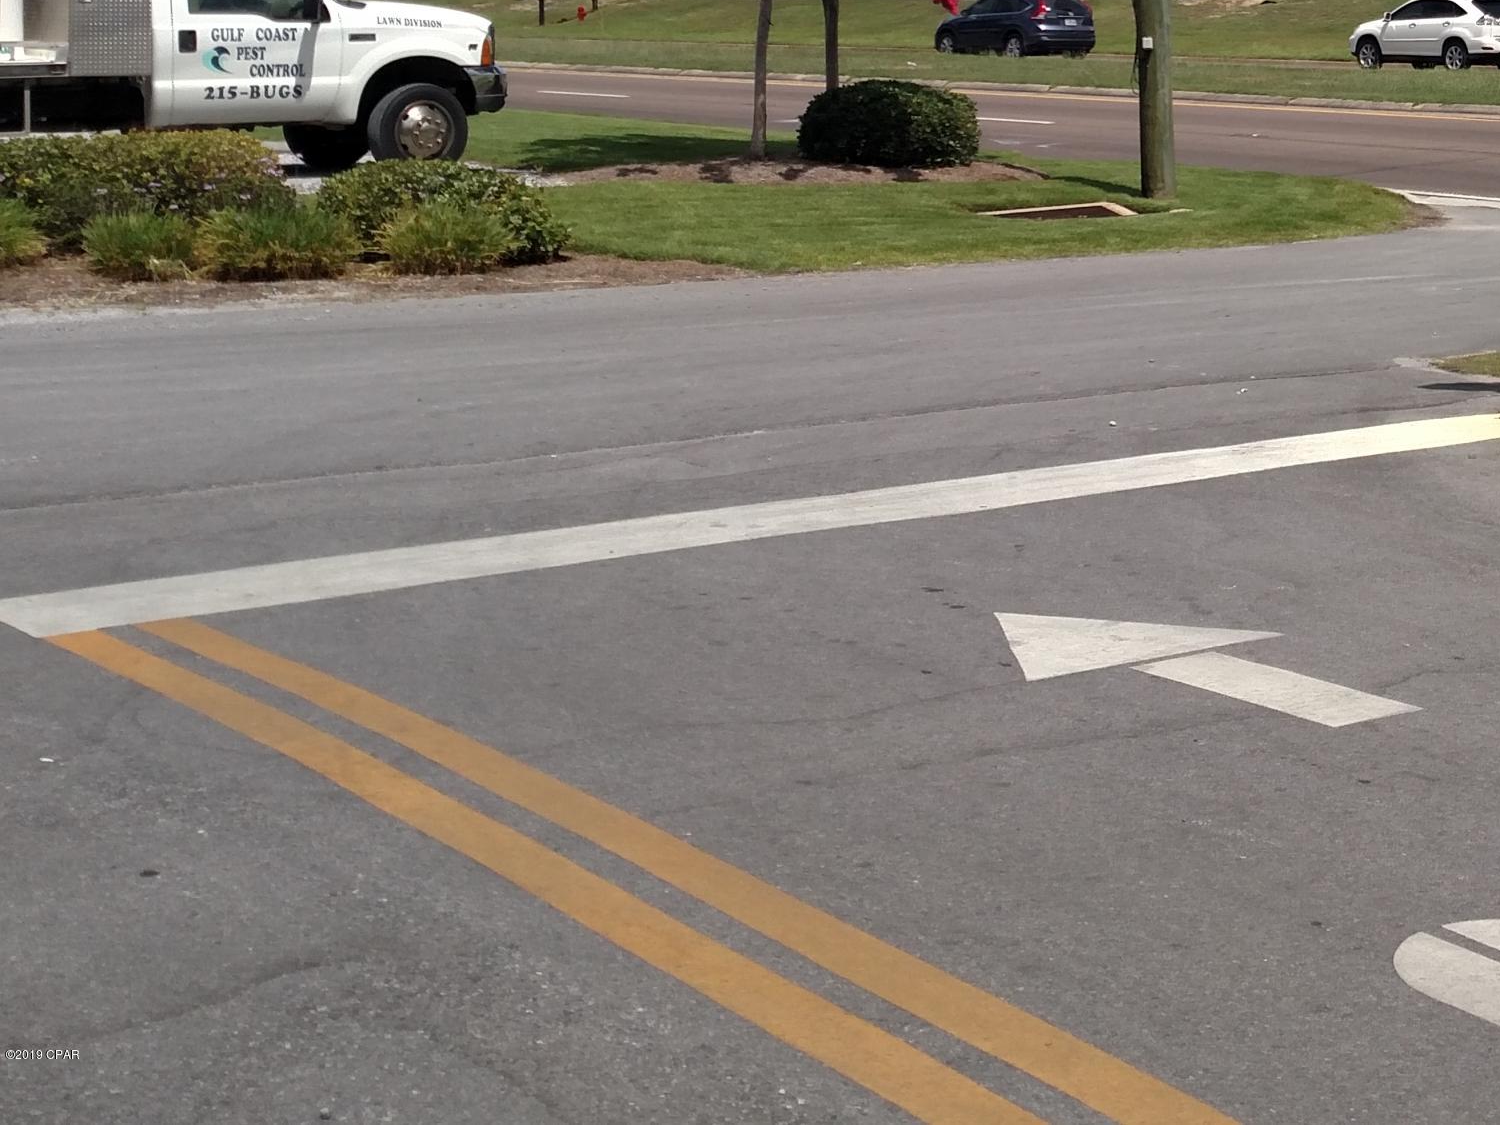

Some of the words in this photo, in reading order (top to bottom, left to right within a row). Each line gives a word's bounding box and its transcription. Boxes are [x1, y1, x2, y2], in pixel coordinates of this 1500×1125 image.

[377, 16, 402, 27] LAWN
[404, 18, 443, 28] DIVISION
[210, 28, 245, 42] GULF
[255, 28, 298, 42] COAST
[236, 46, 267, 61] PEST
[249, 64, 306, 78] CONTROL
[204, 85, 304, 100] 215-BUGS
